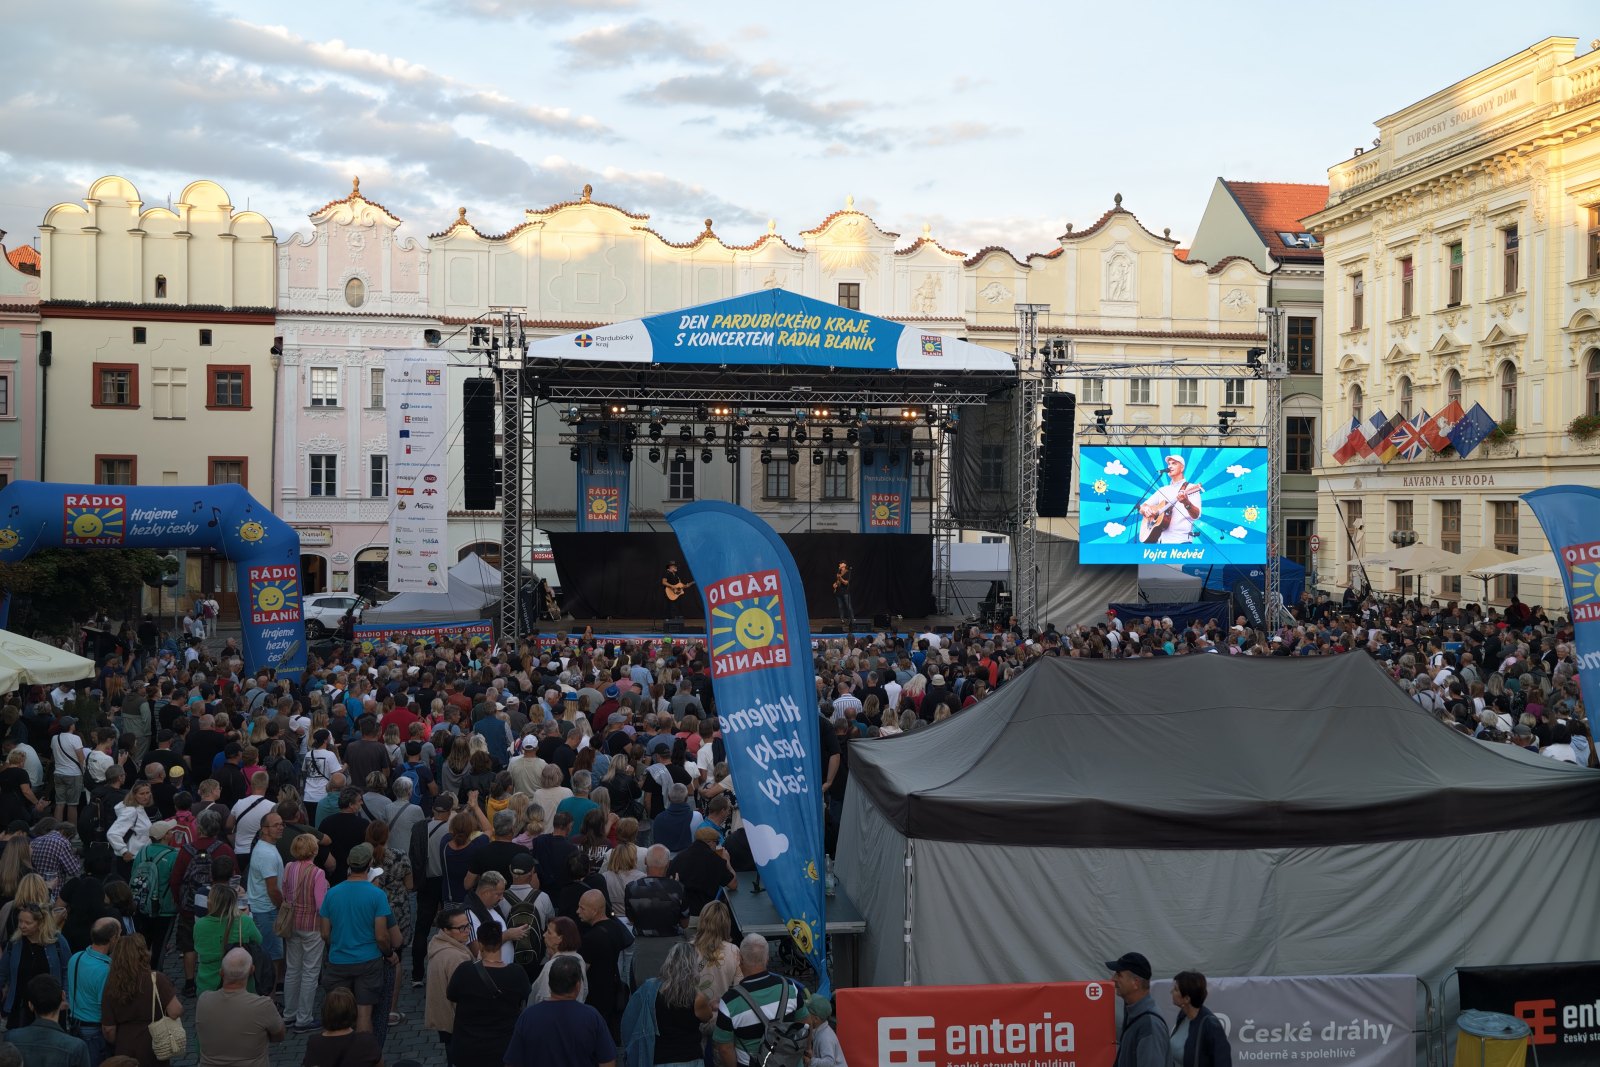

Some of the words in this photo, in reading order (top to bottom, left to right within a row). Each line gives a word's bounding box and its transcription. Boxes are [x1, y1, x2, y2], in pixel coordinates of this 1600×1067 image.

[1407, 119, 1448, 146] EVROPSKÝ
[1450, 97, 1495, 128] SPOLKOVÝ
[1497, 87, 1518, 107] DŮM
[679, 314, 709, 330] DEN
[711, 310, 821, 330] PARDUBICKÉHO
[824, 316, 871, 333] KRAJE
[595, 333, 634, 342] Pardubický
[674, 332, 684, 347] S
[686, 331, 774, 347] KONCERTEM
[777, 328, 820, 348] RÁDIA
[823, 332, 876, 352] BLANÍK
[595, 341, 609, 349] kraj
[1403, 475, 1445, 487] KAVÁRNA
[1451, 474, 1495, 486] EVROPA
[588, 487, 618, 495] RÁDIO
[871, 493, 900, 502] RÁDIO
[66, 494, 123, 506] RÁDIO
[130, 507, 179, 522] Hrajeme
[129, 522, 166, 537] hezky
[166, 521, 200, 536] česky
[64, 536, 121, 545] BLANÍK
[1143, 547, 1167, 562] Vojta
[1169, 547, 1205, 560] Nedvěd
[250, 566, 297, 580] RÁDIO
[253, 609, 300, 623] BLANÍK
[261, 627, 295, 640] Hrajeme
[356, 630, 381, 638] RÁDIO
[411, 627, 435, 636] RÁDIO
[438, 626, 463, 635] RÁDIO
[466, 625, 490, 633] RÁDIO
[265, 639, 291, 651] hezky
[945, 1012, 1075, 1056] enteria
[1238, 1019, 1313, 1043] České
[1320, 1018, 1393, 1045] dráhy
[1563, 1032, 1588, 1044] český
[1239, 1049, 1289, 1061] Moderně
[1290, 1051, 1298, 1060] a
[1300, 1047, 1356, 1062] spolehlivě
